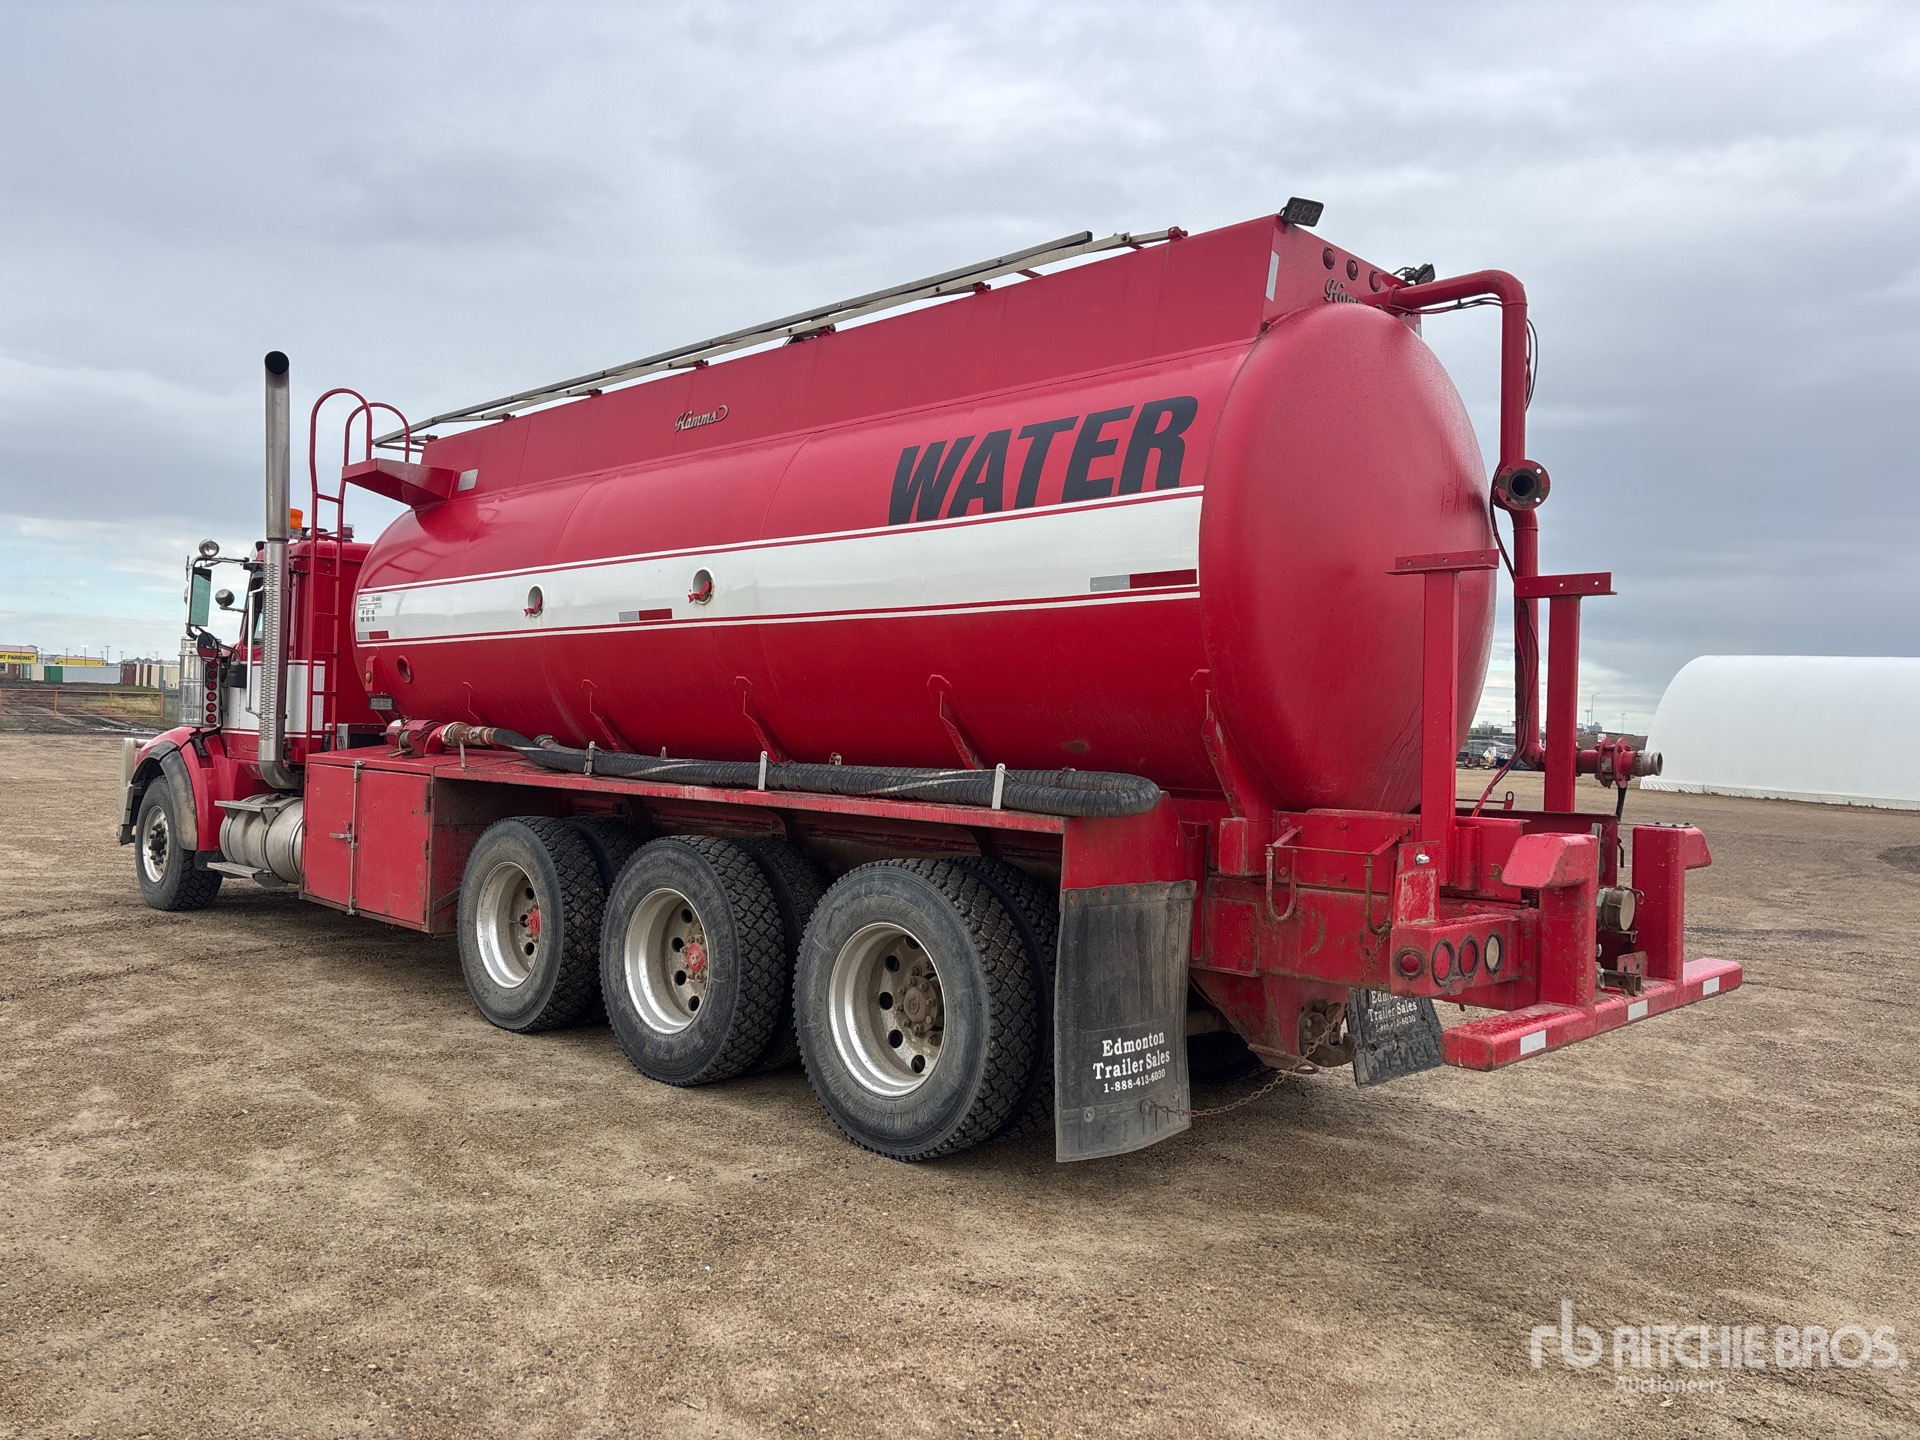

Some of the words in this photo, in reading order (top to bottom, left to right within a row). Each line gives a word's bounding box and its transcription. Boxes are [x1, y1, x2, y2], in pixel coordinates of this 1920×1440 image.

[889, 395, 1198, 525] WATER
[1368, 1006, 1395, 1021] Trailer
[1396, 1000, 1418, 1015] Sales
[1102, 1032, 1165, 1057] Edmonton
[1093, 1057, 1144, 1080] Trailer
[1145, 1049, 1170, 1070] Sales
[1104, 1068, 1166, 1093] 1-888-413-6030
